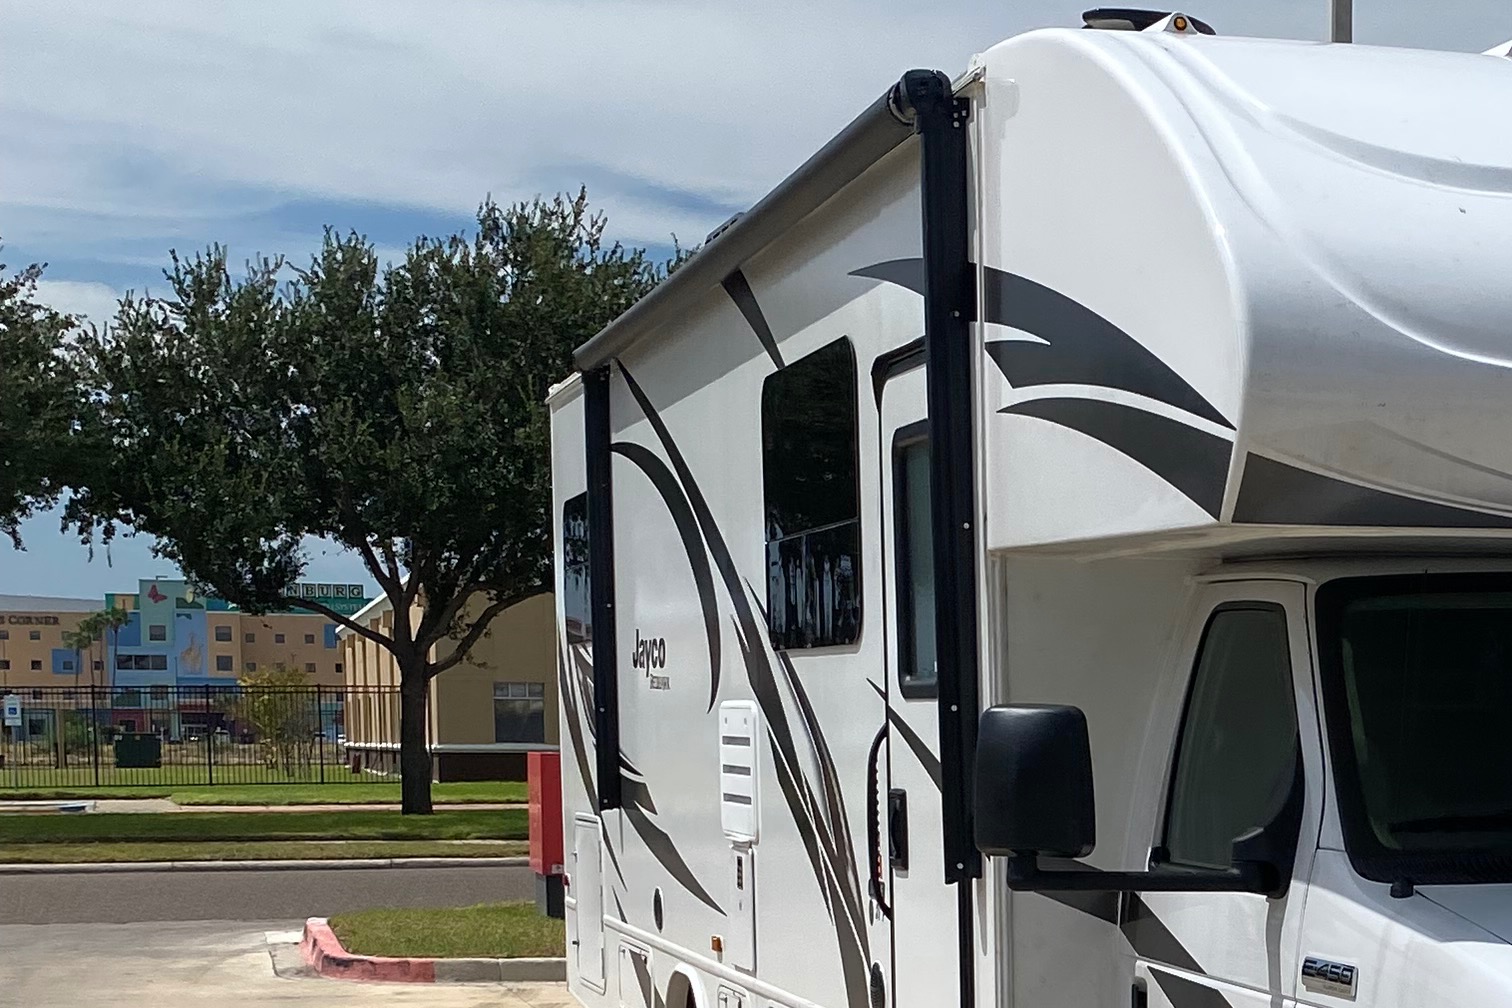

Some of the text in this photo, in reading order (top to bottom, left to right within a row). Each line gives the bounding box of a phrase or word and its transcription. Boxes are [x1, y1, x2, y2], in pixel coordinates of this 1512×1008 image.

[285, 584, 363, 597] NBURG
[8, 615, 60, 625] CORNER
[632, 628, 666, 678] Jayco
